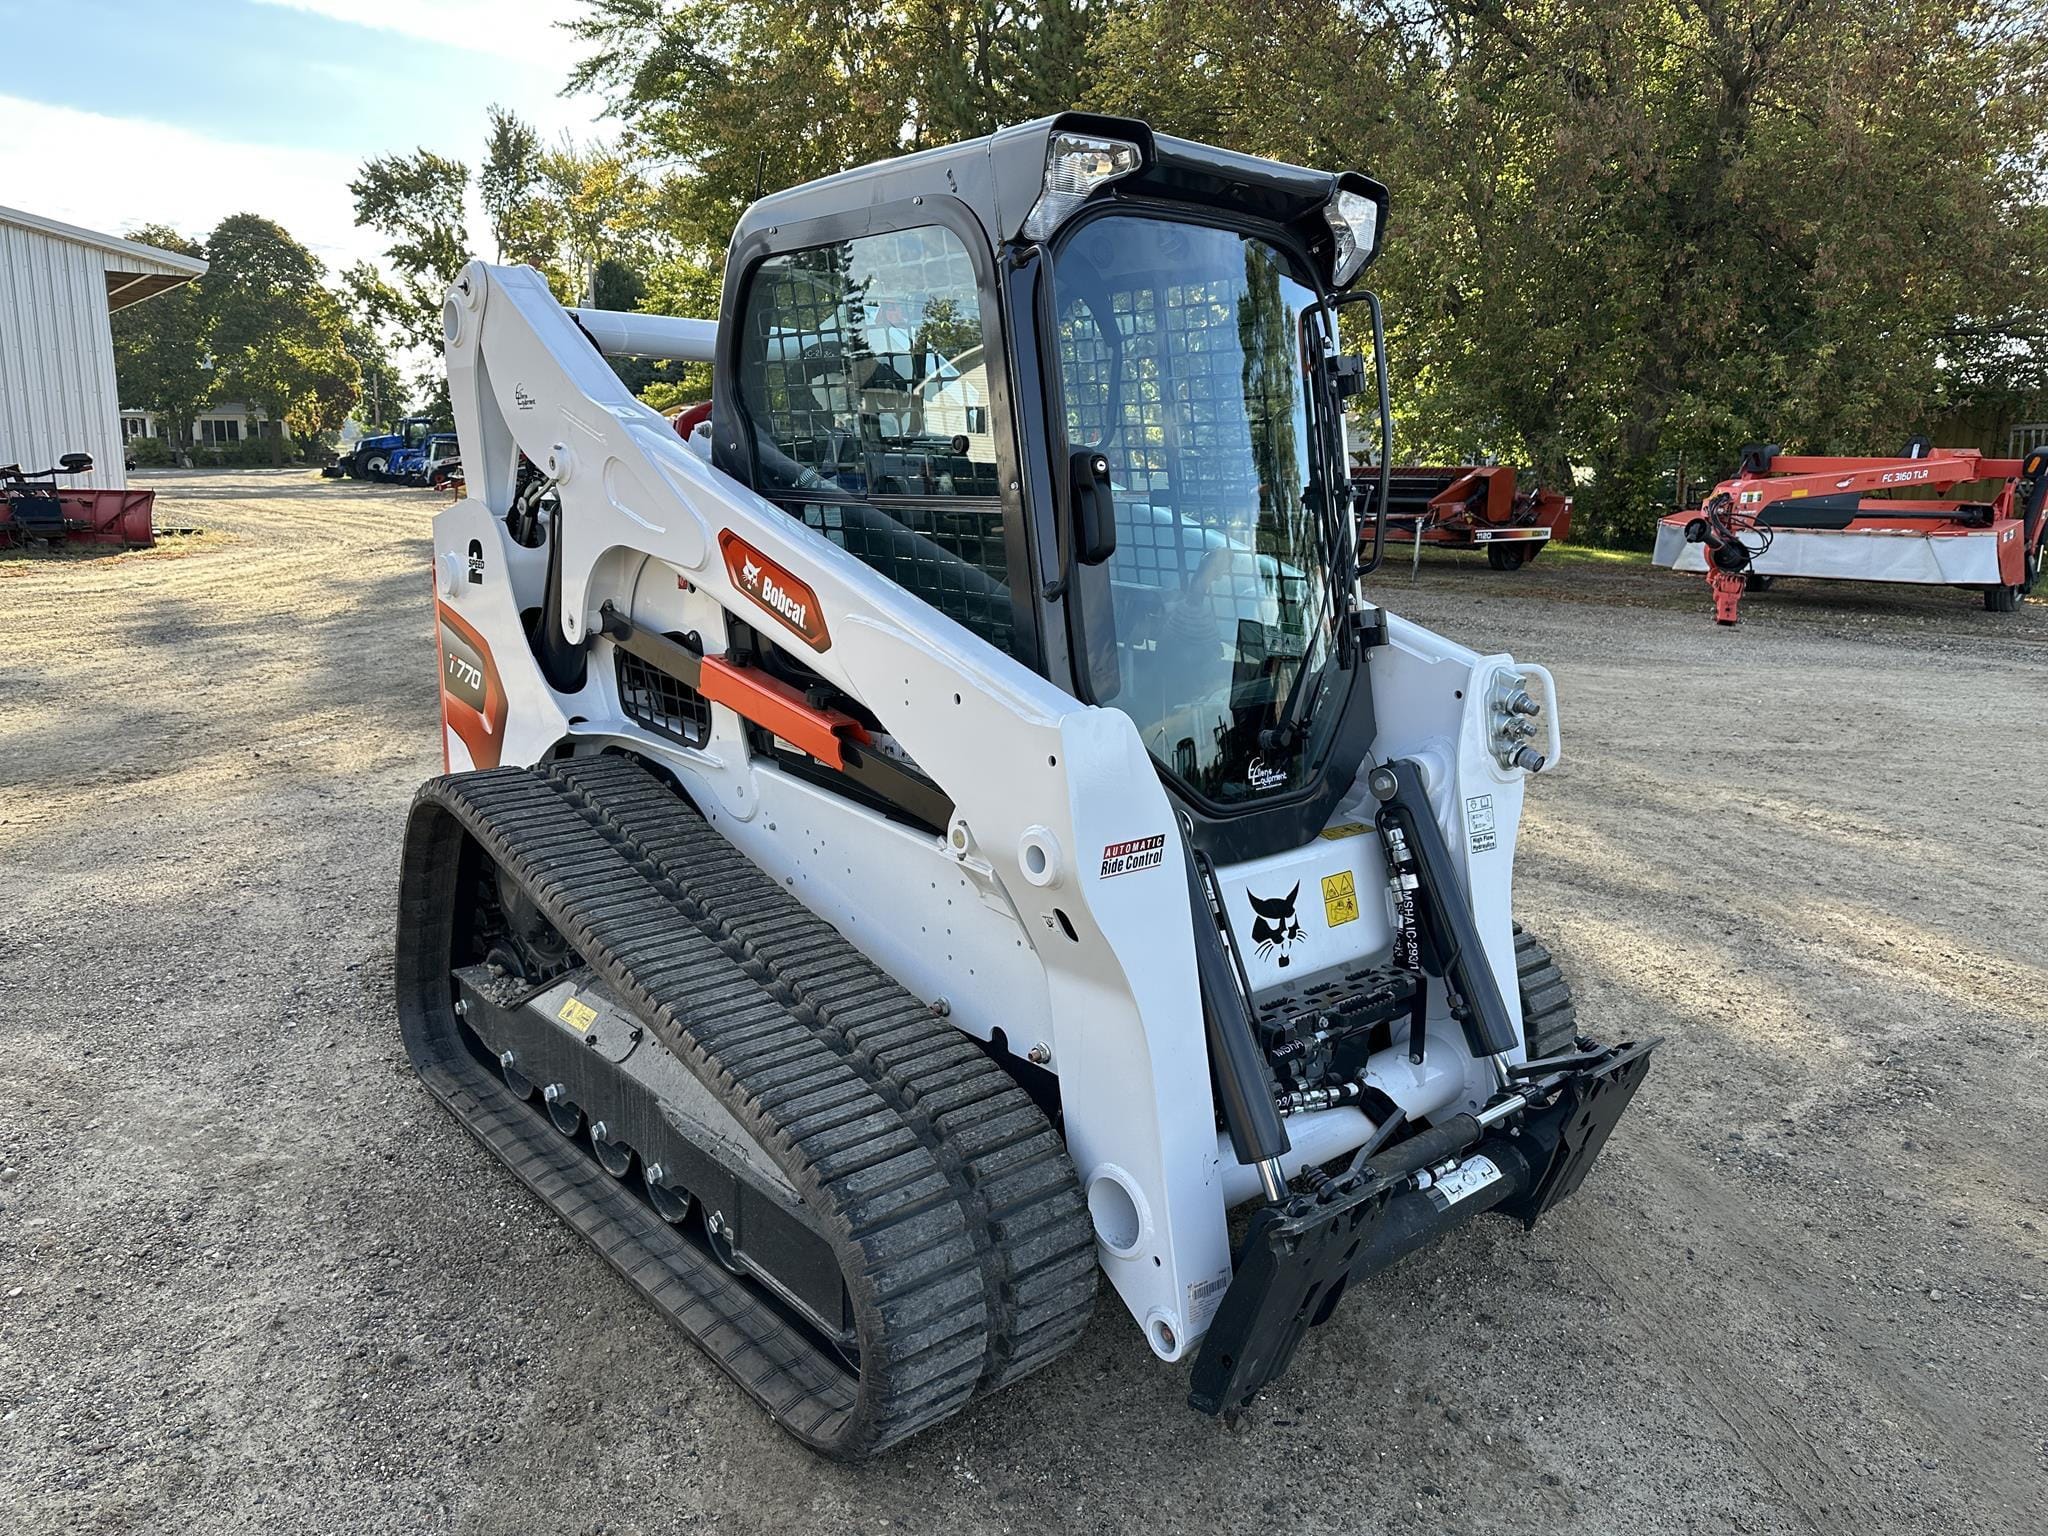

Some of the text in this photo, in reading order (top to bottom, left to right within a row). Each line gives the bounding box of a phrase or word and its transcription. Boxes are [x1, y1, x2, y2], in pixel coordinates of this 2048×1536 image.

[1882, 469, 1929, 483] FC 3160 TLR
[1476, 532, 1492, 540] 1120
[468, 558, 485, 569] SPEED
[761, 575, 806, 629] Bobcat
[1104, 836, 1162, 858] AUTOMATIC
[1100, 848, 1163, 876] Ride Control
[1402, 890, 1419, 970] MSHA IC-293/1
